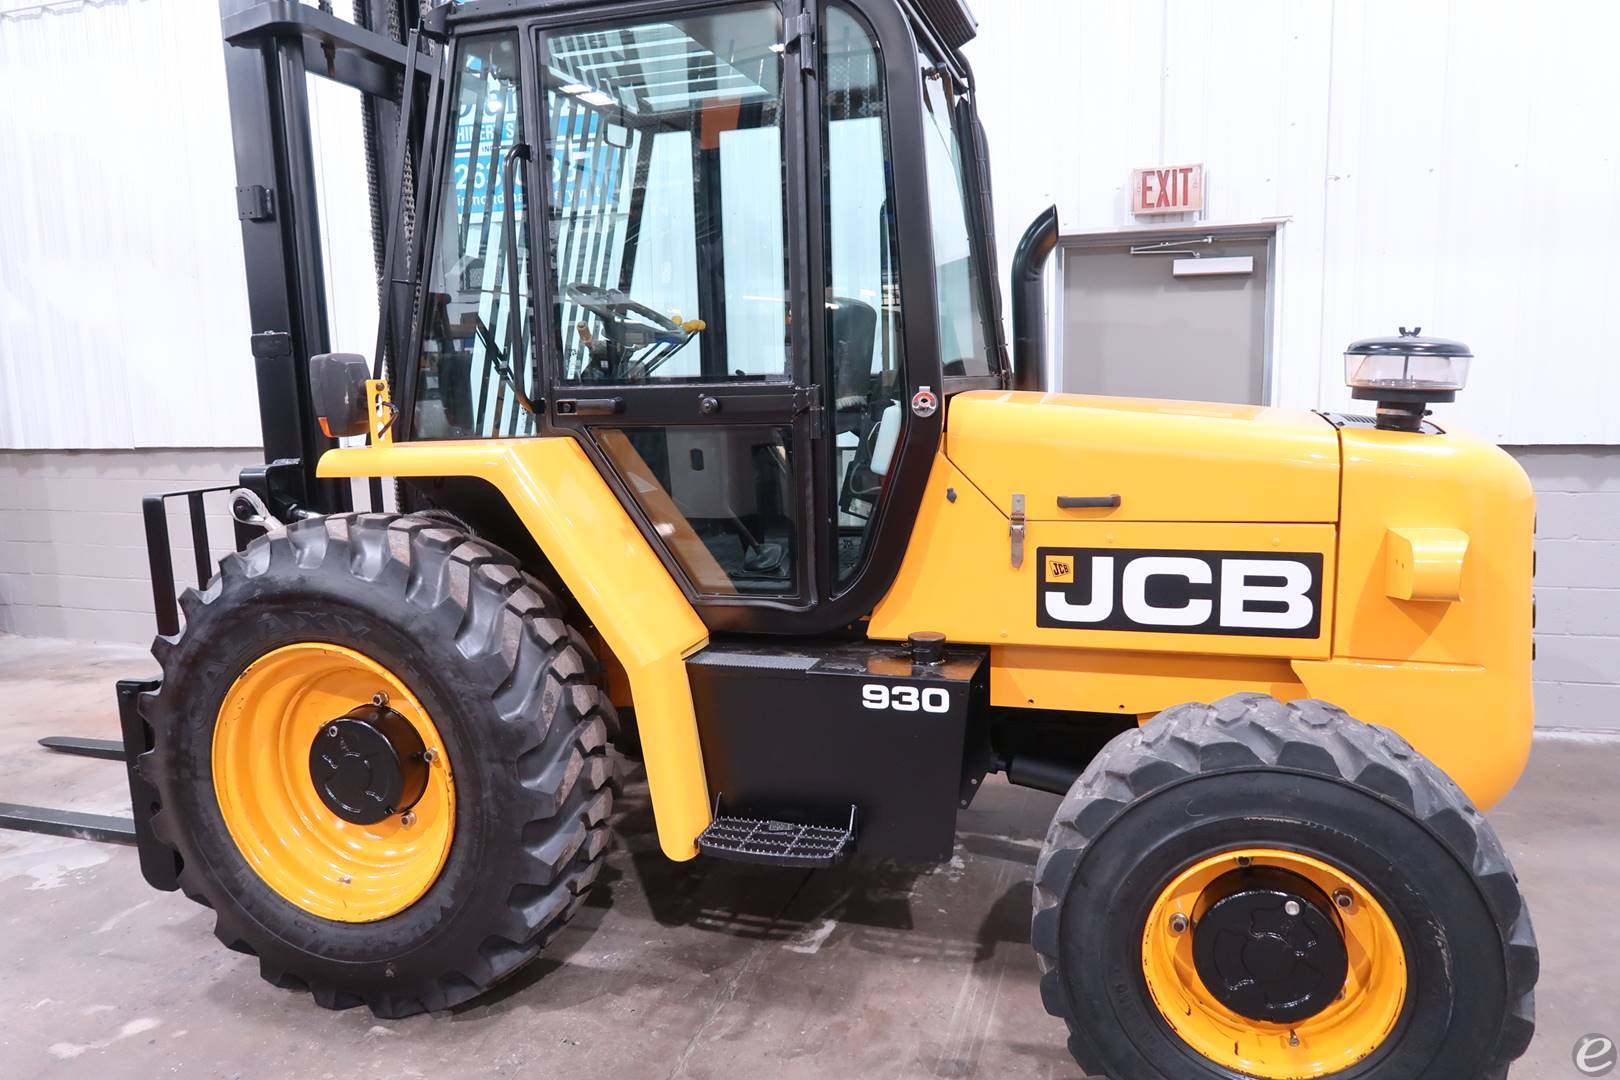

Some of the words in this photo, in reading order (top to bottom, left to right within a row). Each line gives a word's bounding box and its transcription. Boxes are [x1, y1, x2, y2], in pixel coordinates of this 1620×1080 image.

[1141, 168, 1193, 209] EXIT
[1052, 561, 1069, 576] JCB
[1045, 556, 1314, 630] JCB
[862, 683, 950, 713] 930
